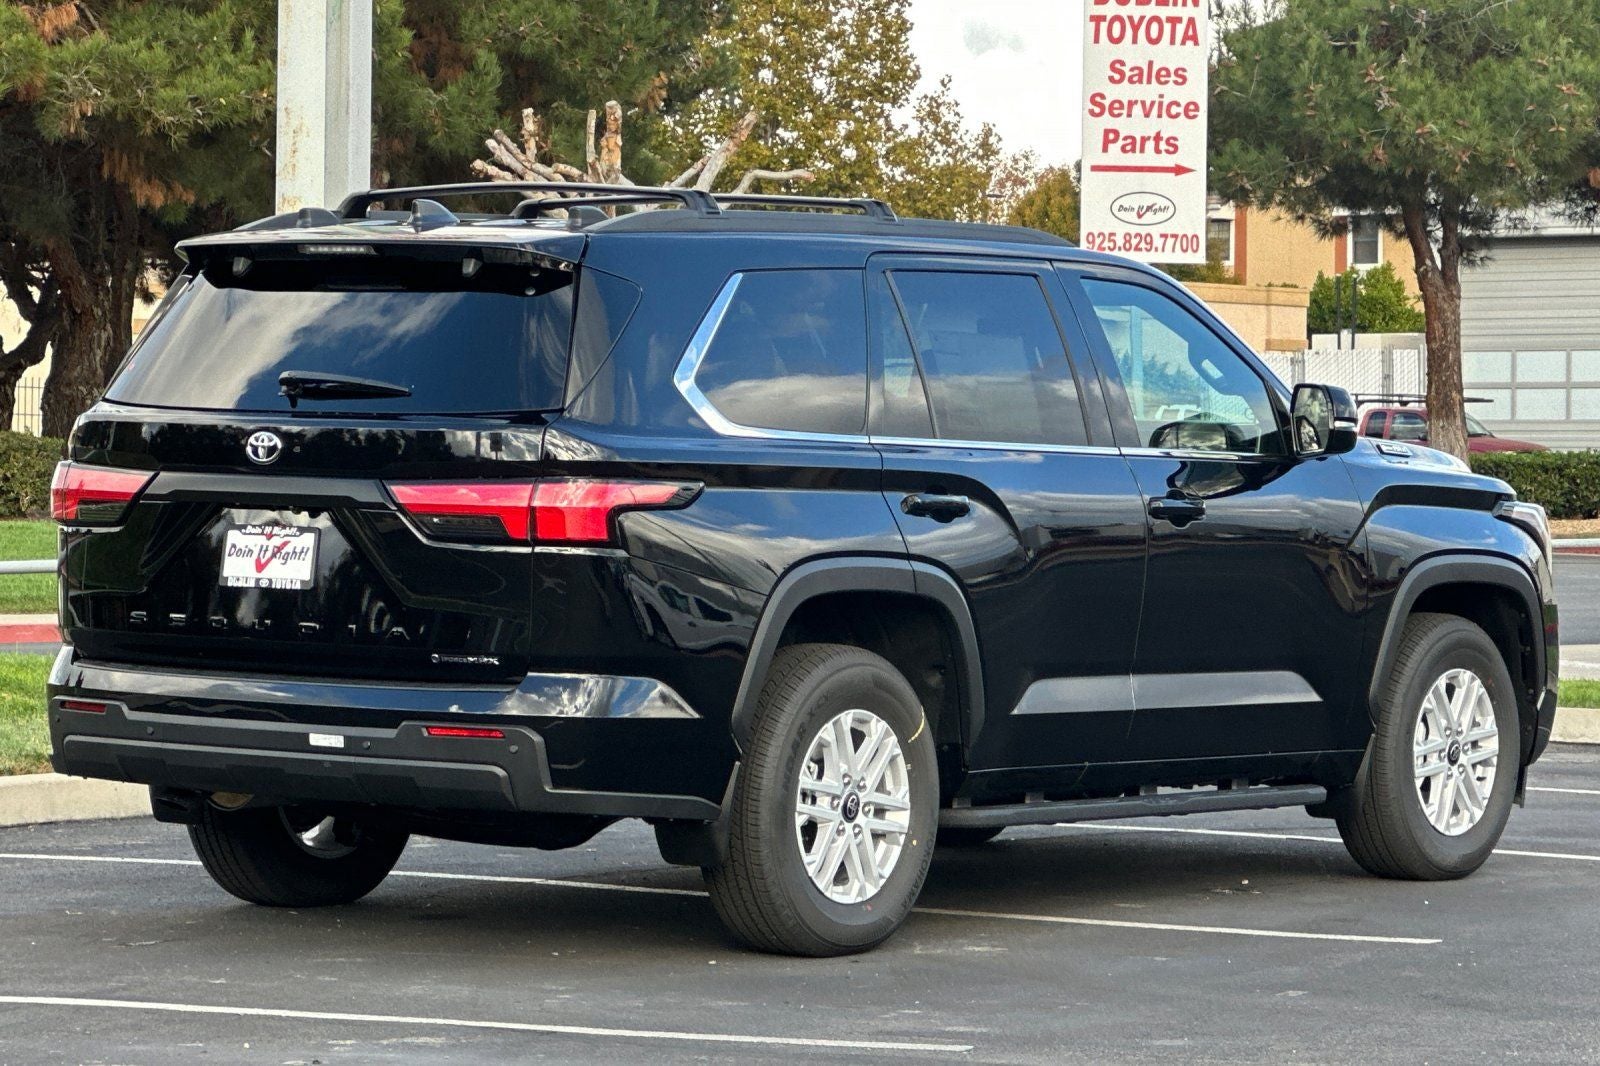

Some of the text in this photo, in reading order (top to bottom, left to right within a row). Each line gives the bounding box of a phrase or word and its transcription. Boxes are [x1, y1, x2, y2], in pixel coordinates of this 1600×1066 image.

[1089, 15, 1199, 46] TOYOTA
[1107, 59, 1188, 86] Sales
[1088, 92, 1200, 120] Service
[1101, 128, 1180, 155] Parts
[1086, 232, 1200, 253] 925.829.7700
[257, 544, 270, 560] It
